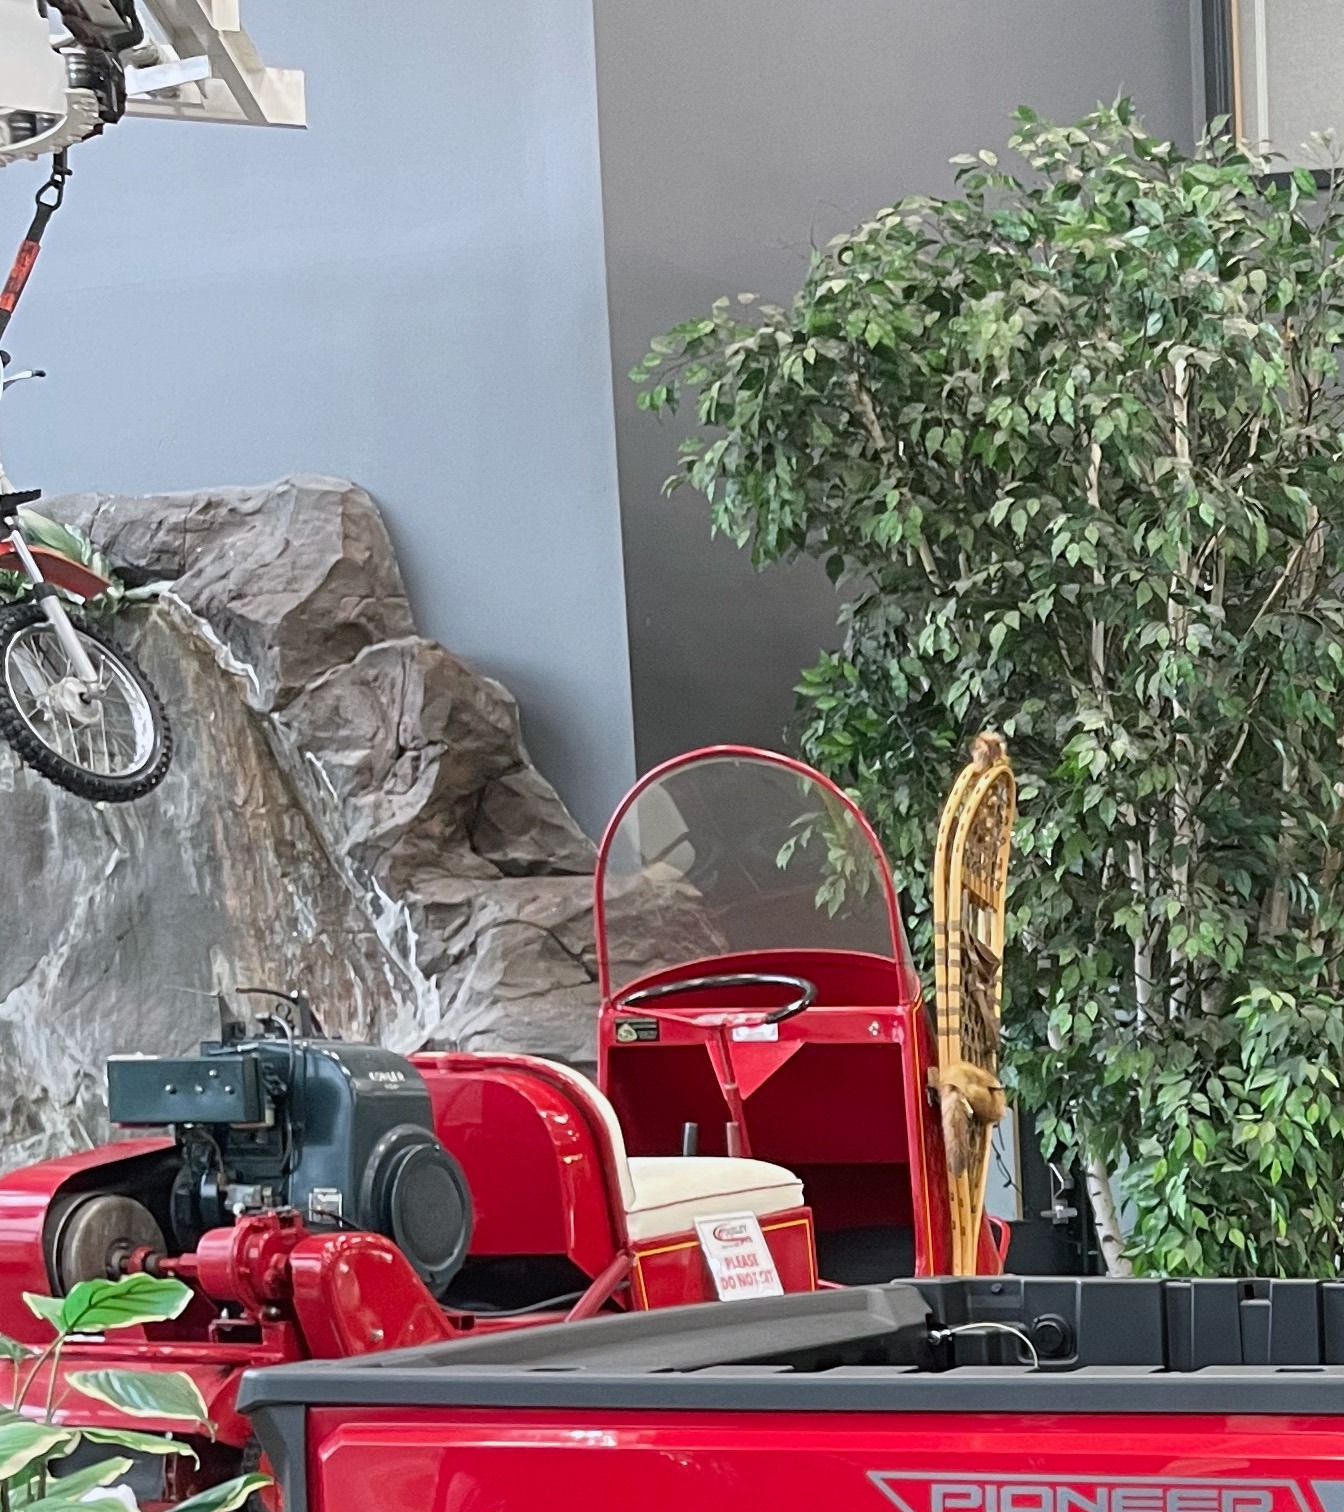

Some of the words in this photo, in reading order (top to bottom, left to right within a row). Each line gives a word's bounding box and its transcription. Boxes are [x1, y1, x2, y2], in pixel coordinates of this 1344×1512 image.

[723, 1253, 760, 1271] PLEASE
[719, 1275, 737, 1291] DO
[736, 1271, 759, 1288] NOT
